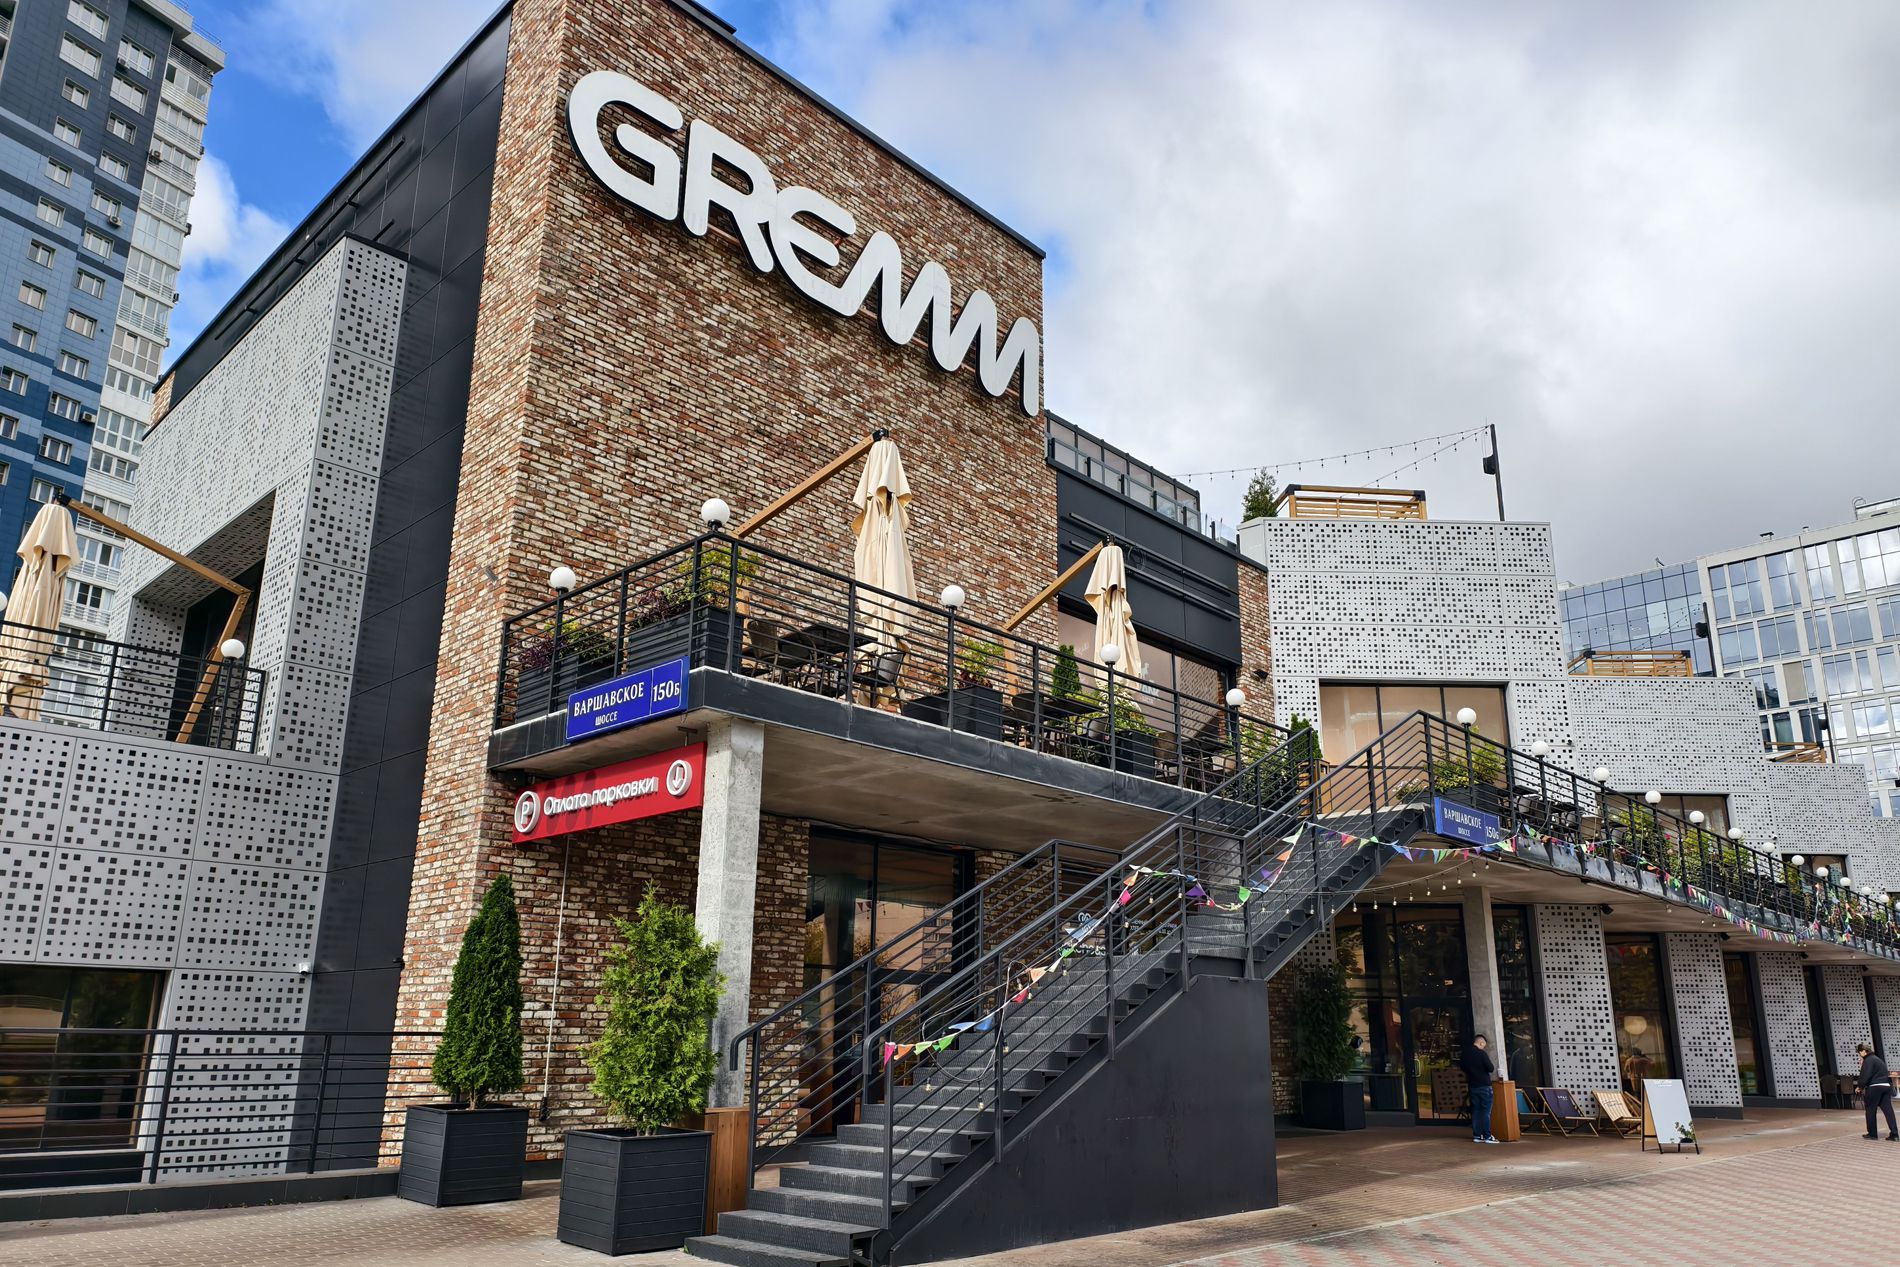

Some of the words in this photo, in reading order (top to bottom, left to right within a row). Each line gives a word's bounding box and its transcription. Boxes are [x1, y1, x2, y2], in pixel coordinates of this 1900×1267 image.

[566, 70, 1039, 417] GREMM
[573, 682, 645, 716] ВАРШАВСКОЕ
[595, 711, 618, 726] ШОССЕ
[544, 793, 588, 816] Оплата
[591, 777, 658, 806] парковки
[1444, 808, 1482, 829] ВАРШАВСКОЕ
